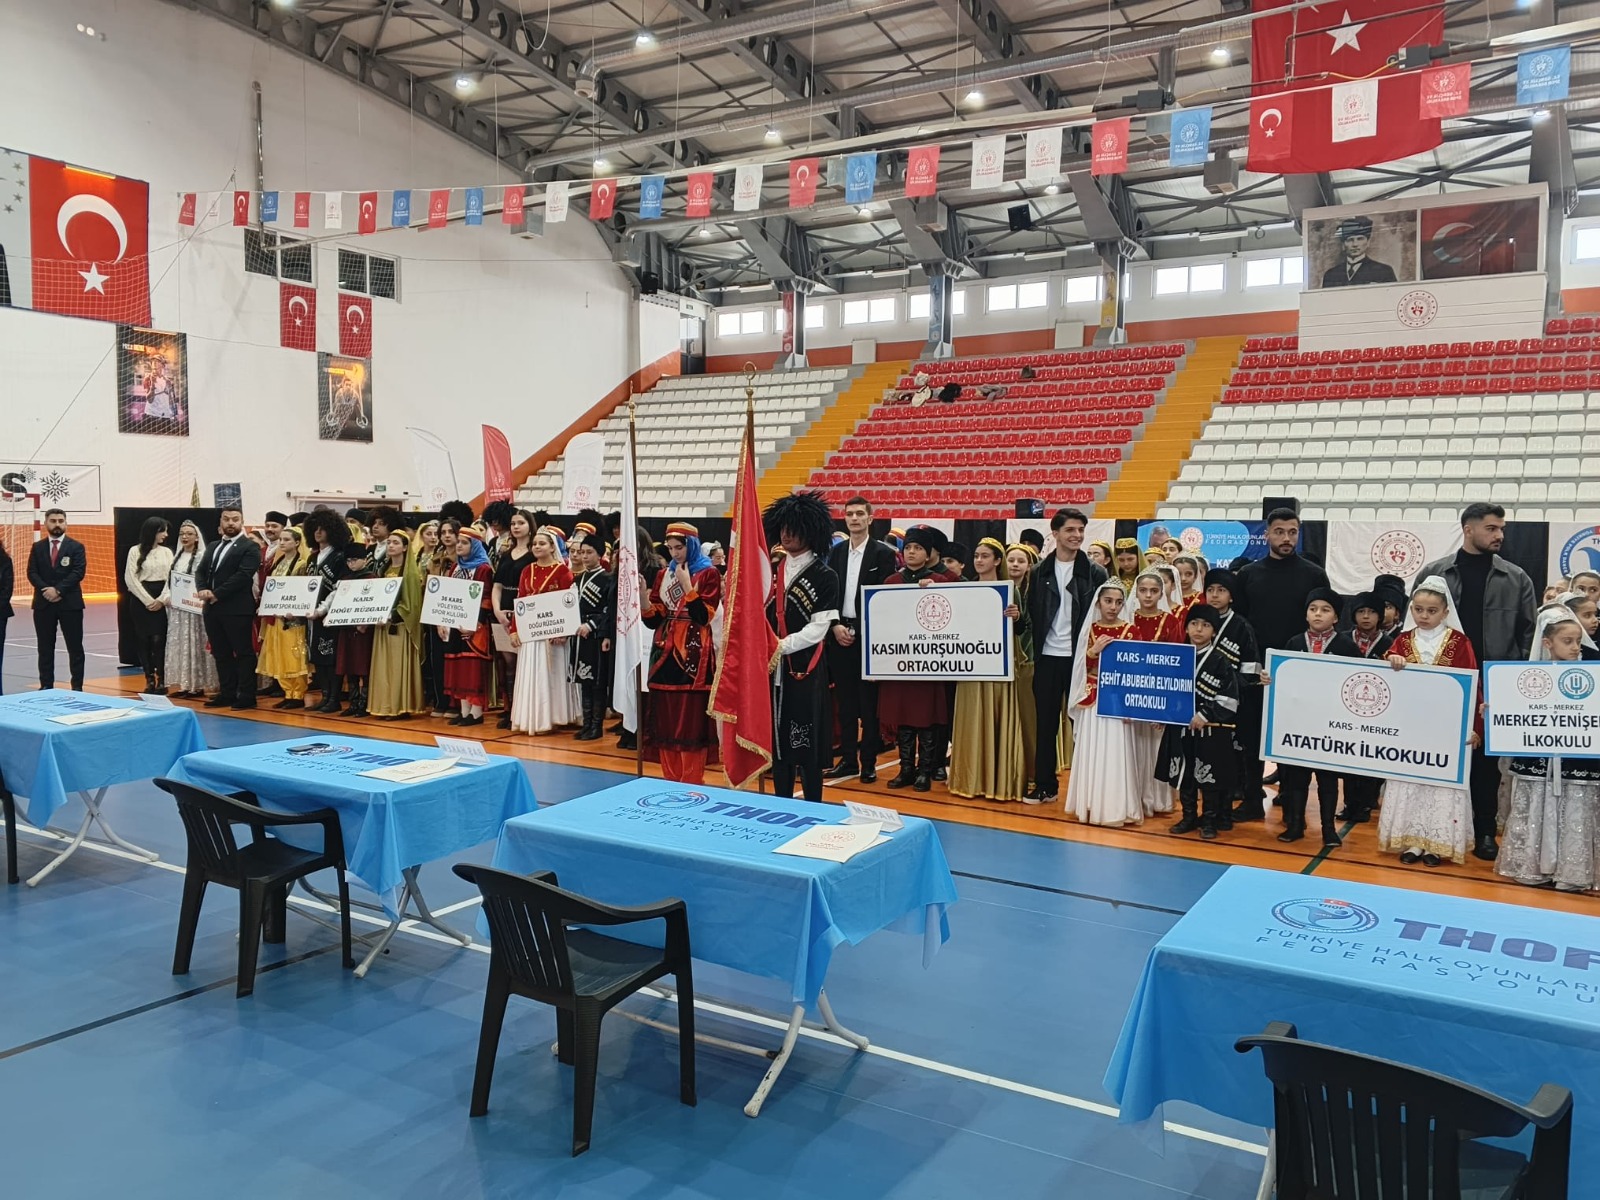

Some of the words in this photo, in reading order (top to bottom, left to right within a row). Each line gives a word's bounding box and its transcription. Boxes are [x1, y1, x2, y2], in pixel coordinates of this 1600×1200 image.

[292, 602, 311, 610] KULÜBÜ
[437, 602, 464, 611] VOLEYBOL
[448, 596, 463, 604] KARS
[330, 606, 353, 614] DOĞU
[446, 610, 468, 619] KULÜBÜ
[537, 611, 554, 619] KARS
[350, 616, 384, 624] KULÜBÜ
[528, 621, 543, 630] DOĞU
[543, 618, 565, 627] RÜZGARI
[543, 626, 564, 635] KULÜBÜ
[908, 633, 927, 641] KARS
[931, 633, 960, 641] MERKEZ
[871, 643, 910, 655] KASIM
[912, 640, 1002, 658] KURŞUNOĞLU
[897, 660, 974, 672] ORTAOKULU
[1116, 651, 1140, 663] KARS
[1146, 653, 1181, 667] MERKEZ
[1100, 670, 1121, 688] ŞEHİT
[1121, 673, 1156, 689] ABUBEKİR
[1156, 677, 1193, 693] ELYILDIRIM
[1124, 693, 1167, 710] ORTAOKULU
[1328, 720, 1353, 732] KARS
[1360, 724, 1400, 737] MERKEZ
[1493, 714, 1548, 727] MERKEZ
[1523, 731, 1592, 748] İLKOKULU
[1281, 732, 1356, 757] ATATÜRK
[1359, 740, 1450, 768] İLKOKULU
[614, 806, 671, 818] TÜRKİYE
[670, 815, 708, 825] HALK
[711, 822, 786, 840] OYUNLARI
[702, 801, 826, 829] THOF
[600, 810, 774, 844] FEDERASYONU
[1394, 918, 1600, 971] THOF
[1264, 927, 1365, 951] TÜRKİYE
[1374, 946, 1443, 964] HALK
[1453, 960, 1600, 994] OYUNLARI
[1255, 935, 1595, 1004] FEDERASYONU
